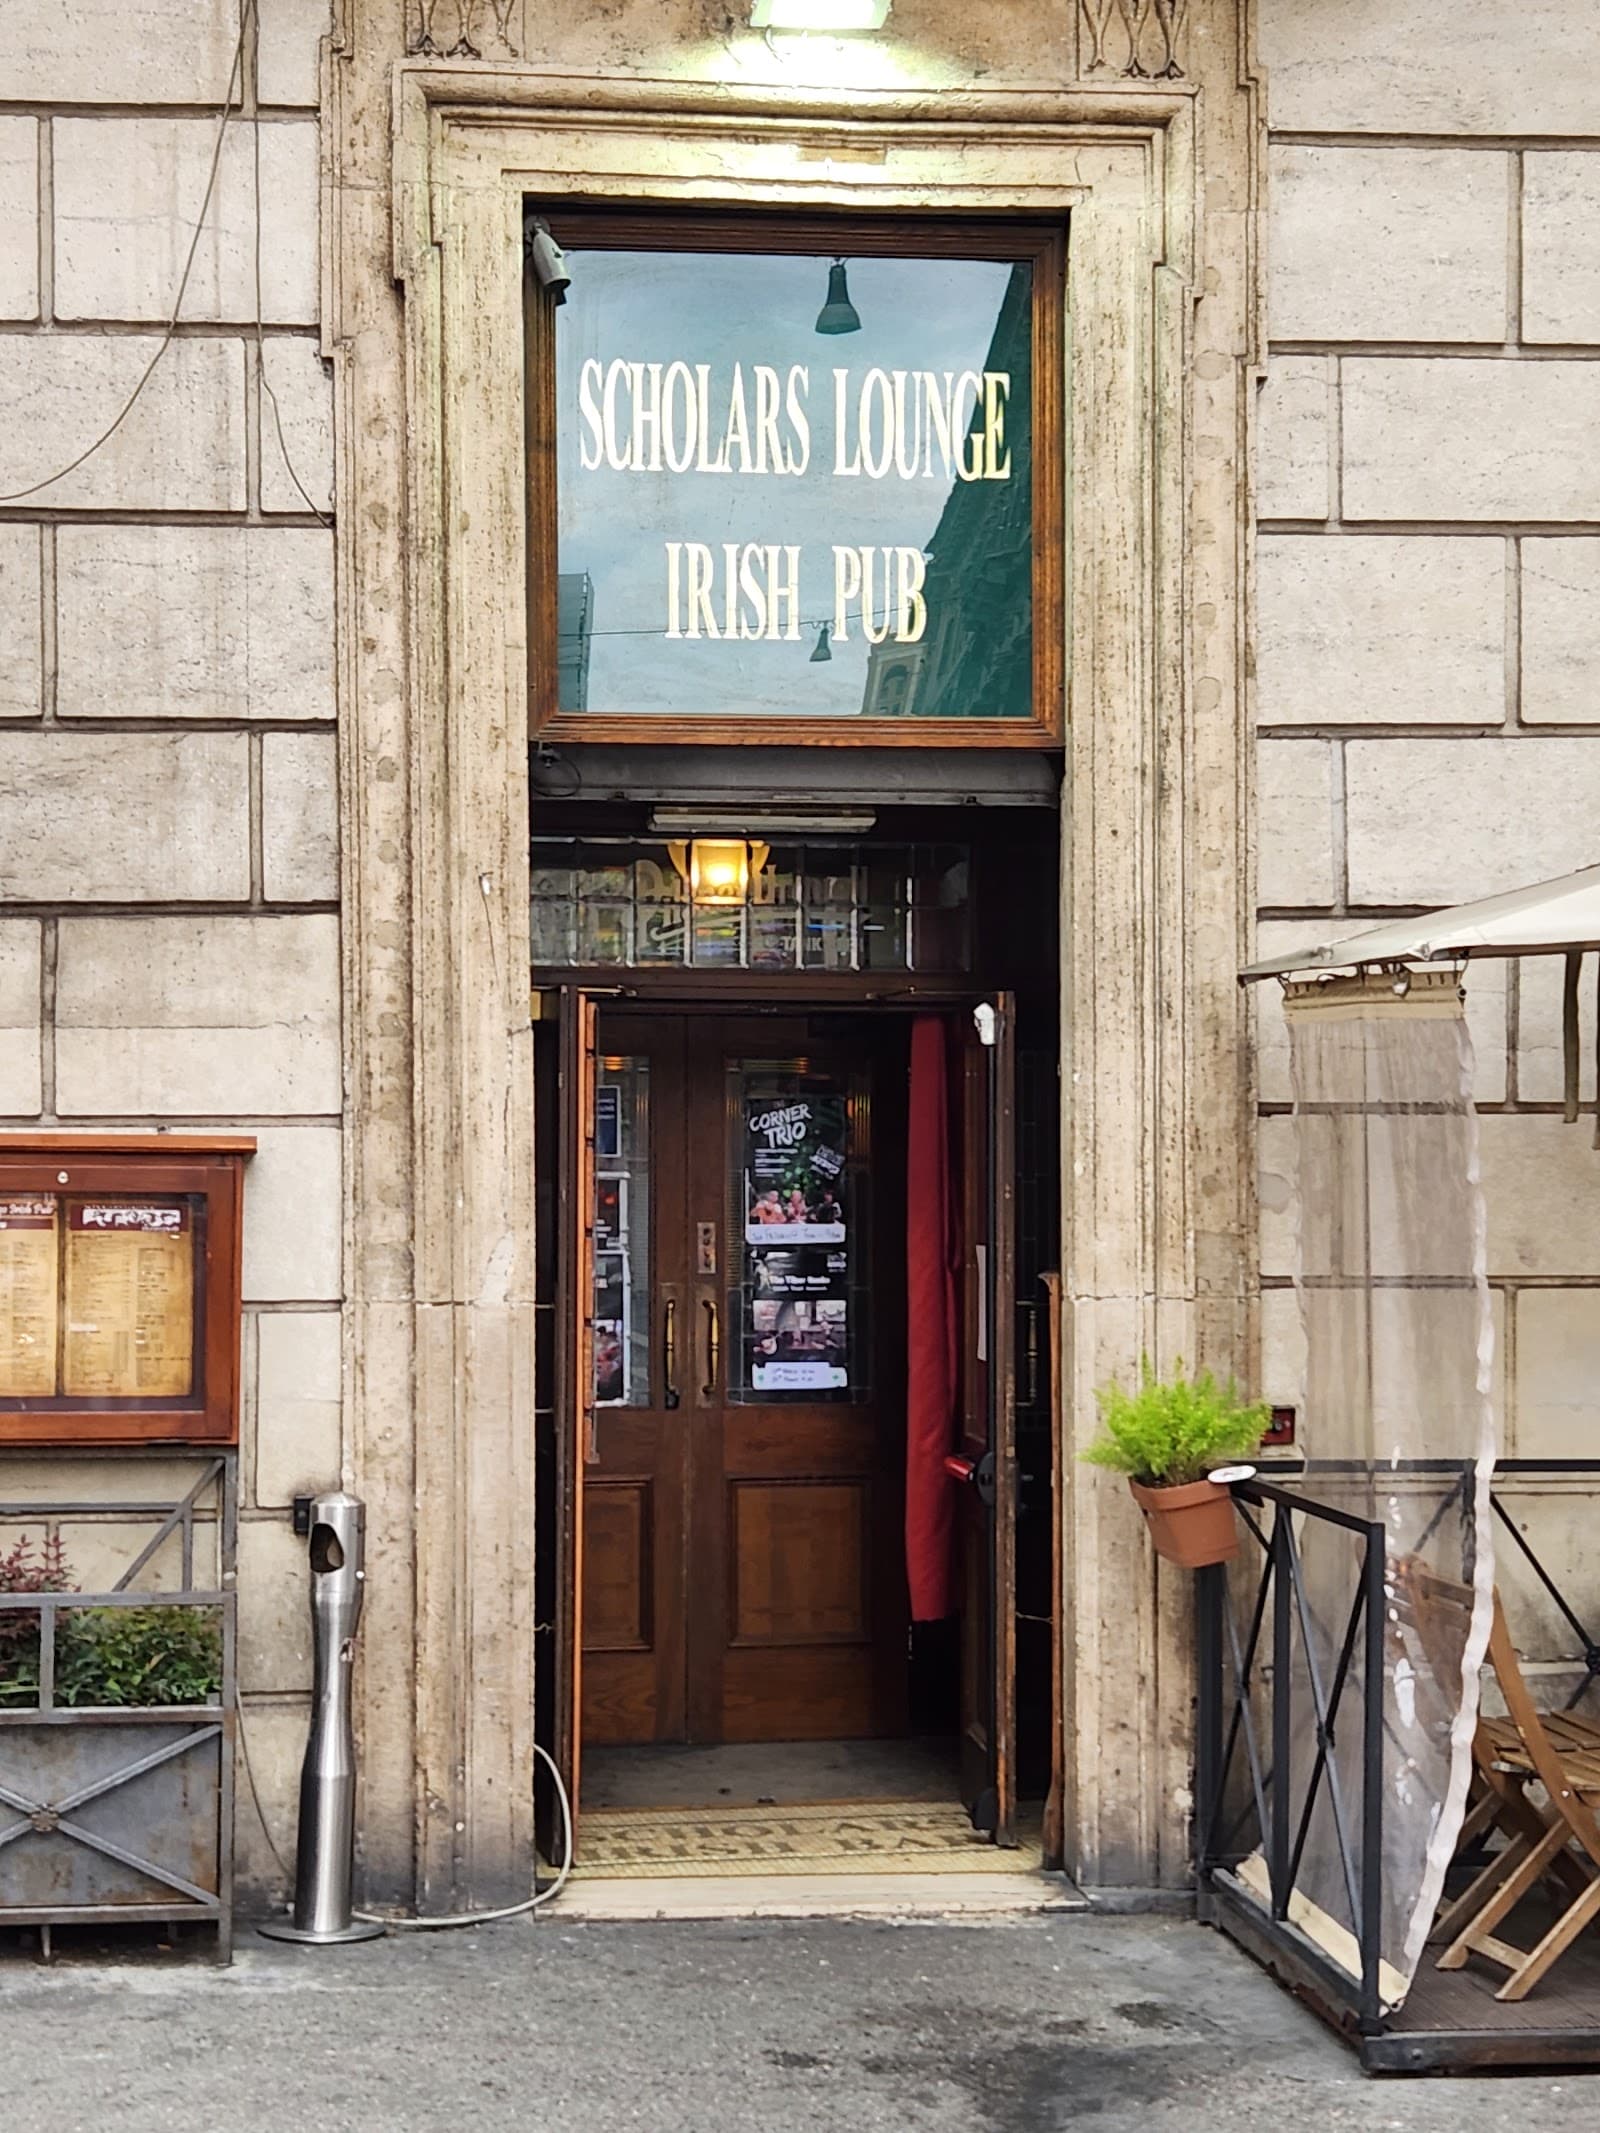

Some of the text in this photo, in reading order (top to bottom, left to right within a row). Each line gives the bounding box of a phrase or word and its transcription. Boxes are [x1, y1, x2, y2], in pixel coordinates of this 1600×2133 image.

[579, 358, 1012, 482] SCHOLARS LOUNGE
[664, 542, 928, 644] IRISH PUB
[750, 1103, 813, 1132] CORNER
[762, 1121, 807, 1149] TRIO
